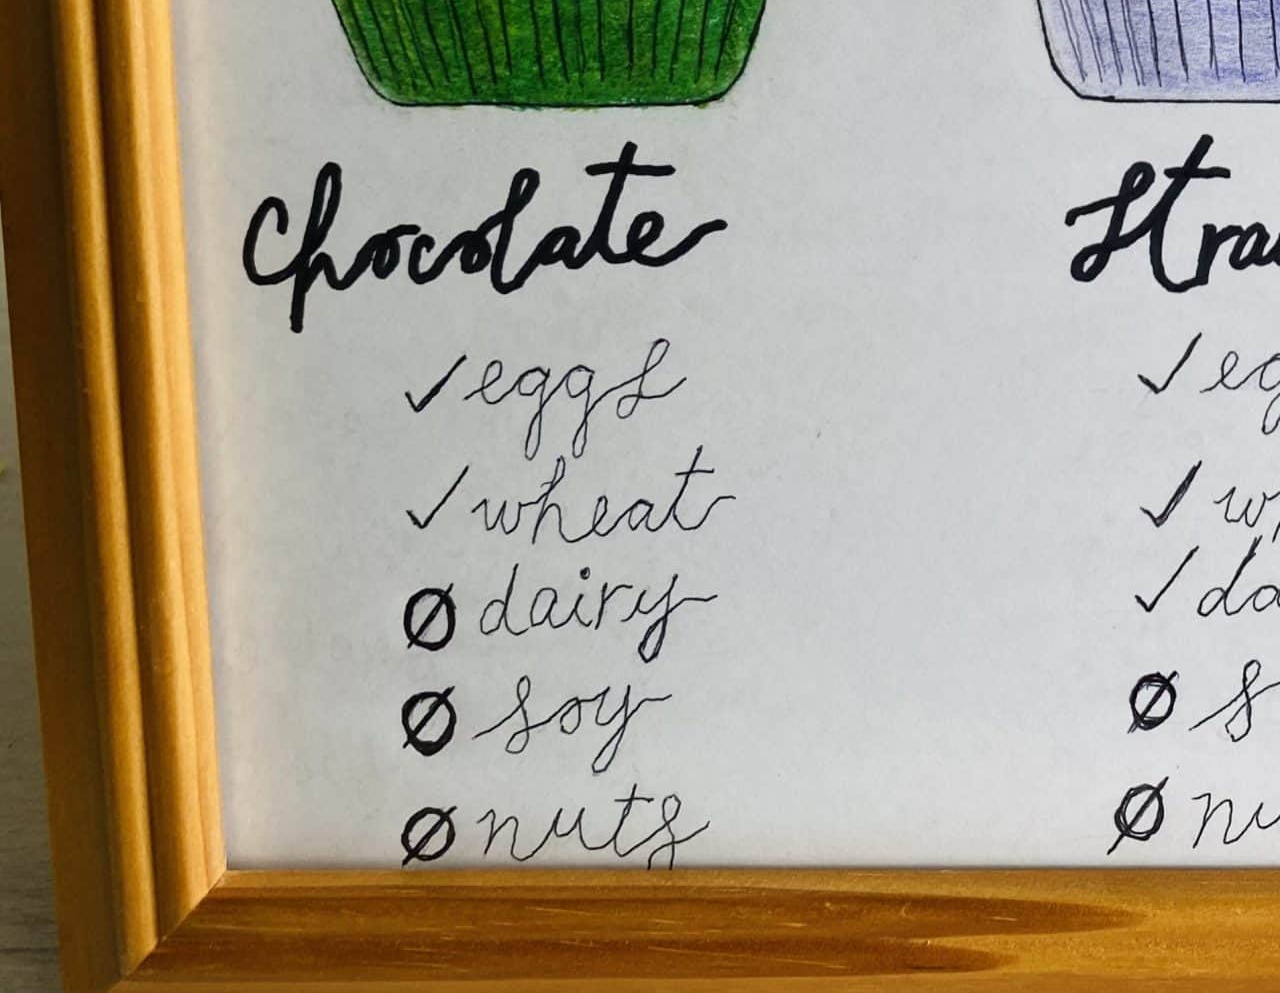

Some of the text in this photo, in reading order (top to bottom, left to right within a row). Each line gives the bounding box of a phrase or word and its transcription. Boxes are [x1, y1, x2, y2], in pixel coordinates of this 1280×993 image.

[462, 338, 688, 460] eggs
[470, 446, 737, 544] wheat
[479, 563, 719, 664] dairy
[472, 675, 673, 776] soy
[475, 783, 711, 870] nuts
